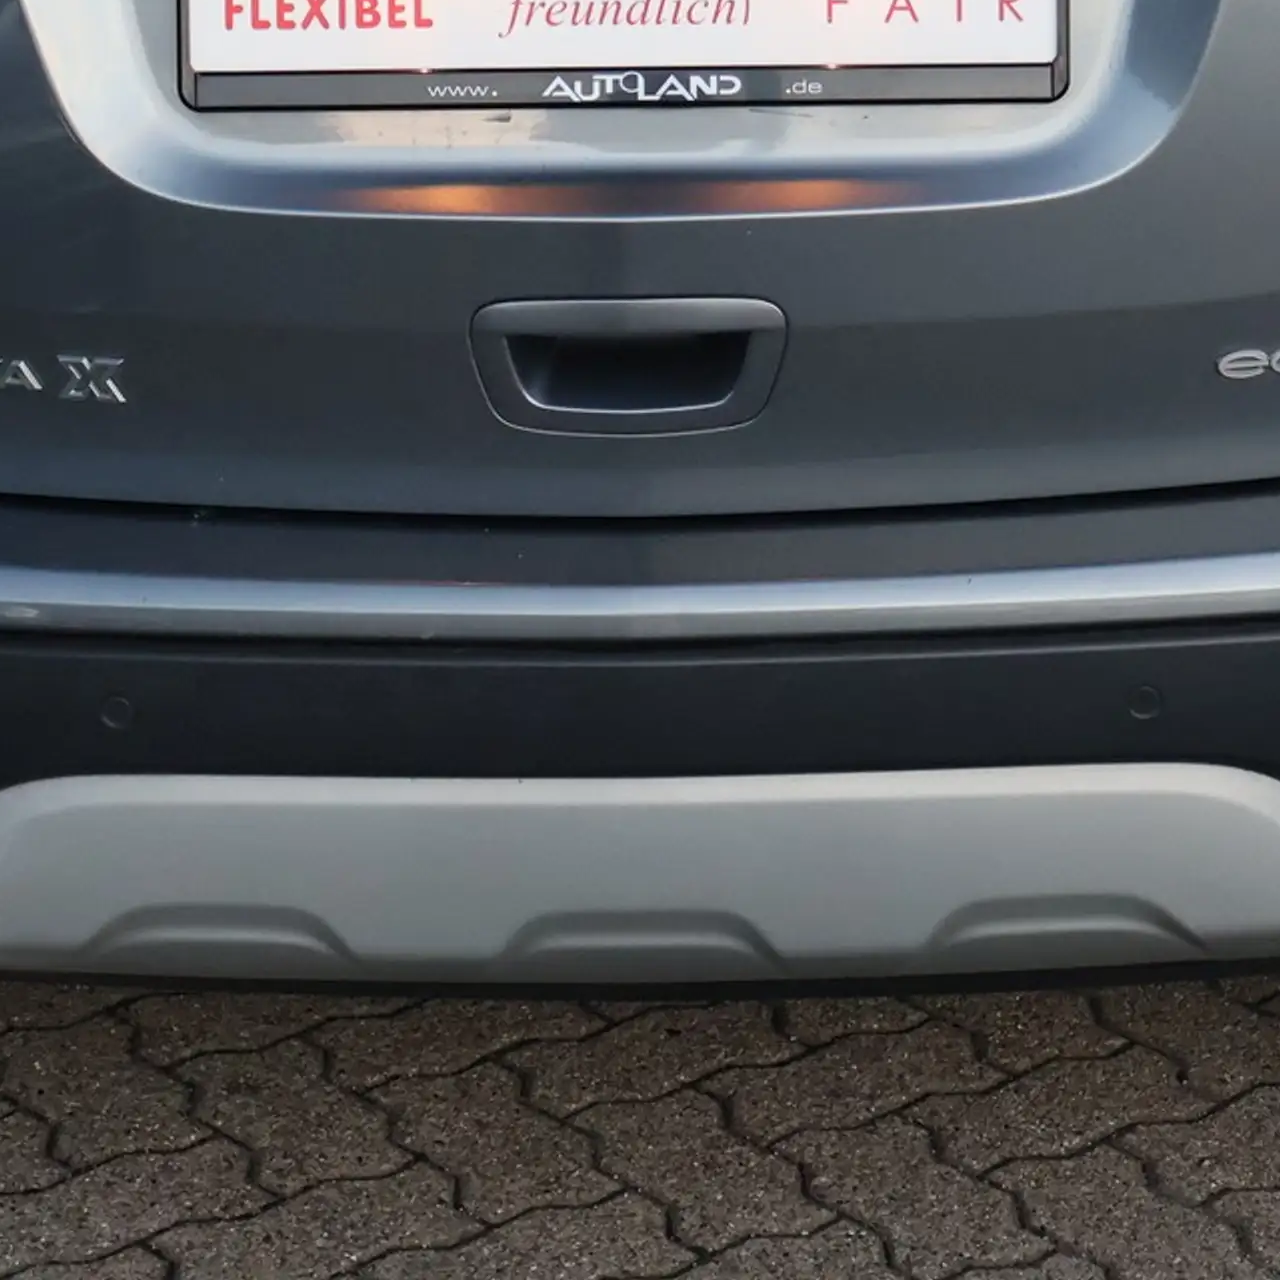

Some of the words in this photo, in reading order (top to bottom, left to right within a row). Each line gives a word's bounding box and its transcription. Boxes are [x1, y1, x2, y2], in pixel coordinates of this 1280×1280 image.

[427, 85, 499, 98] www.
[542, 71, 742, 102] AUTOLAND
[784, 79, 823, 95] .de
[56, 353, 128, 405] X
